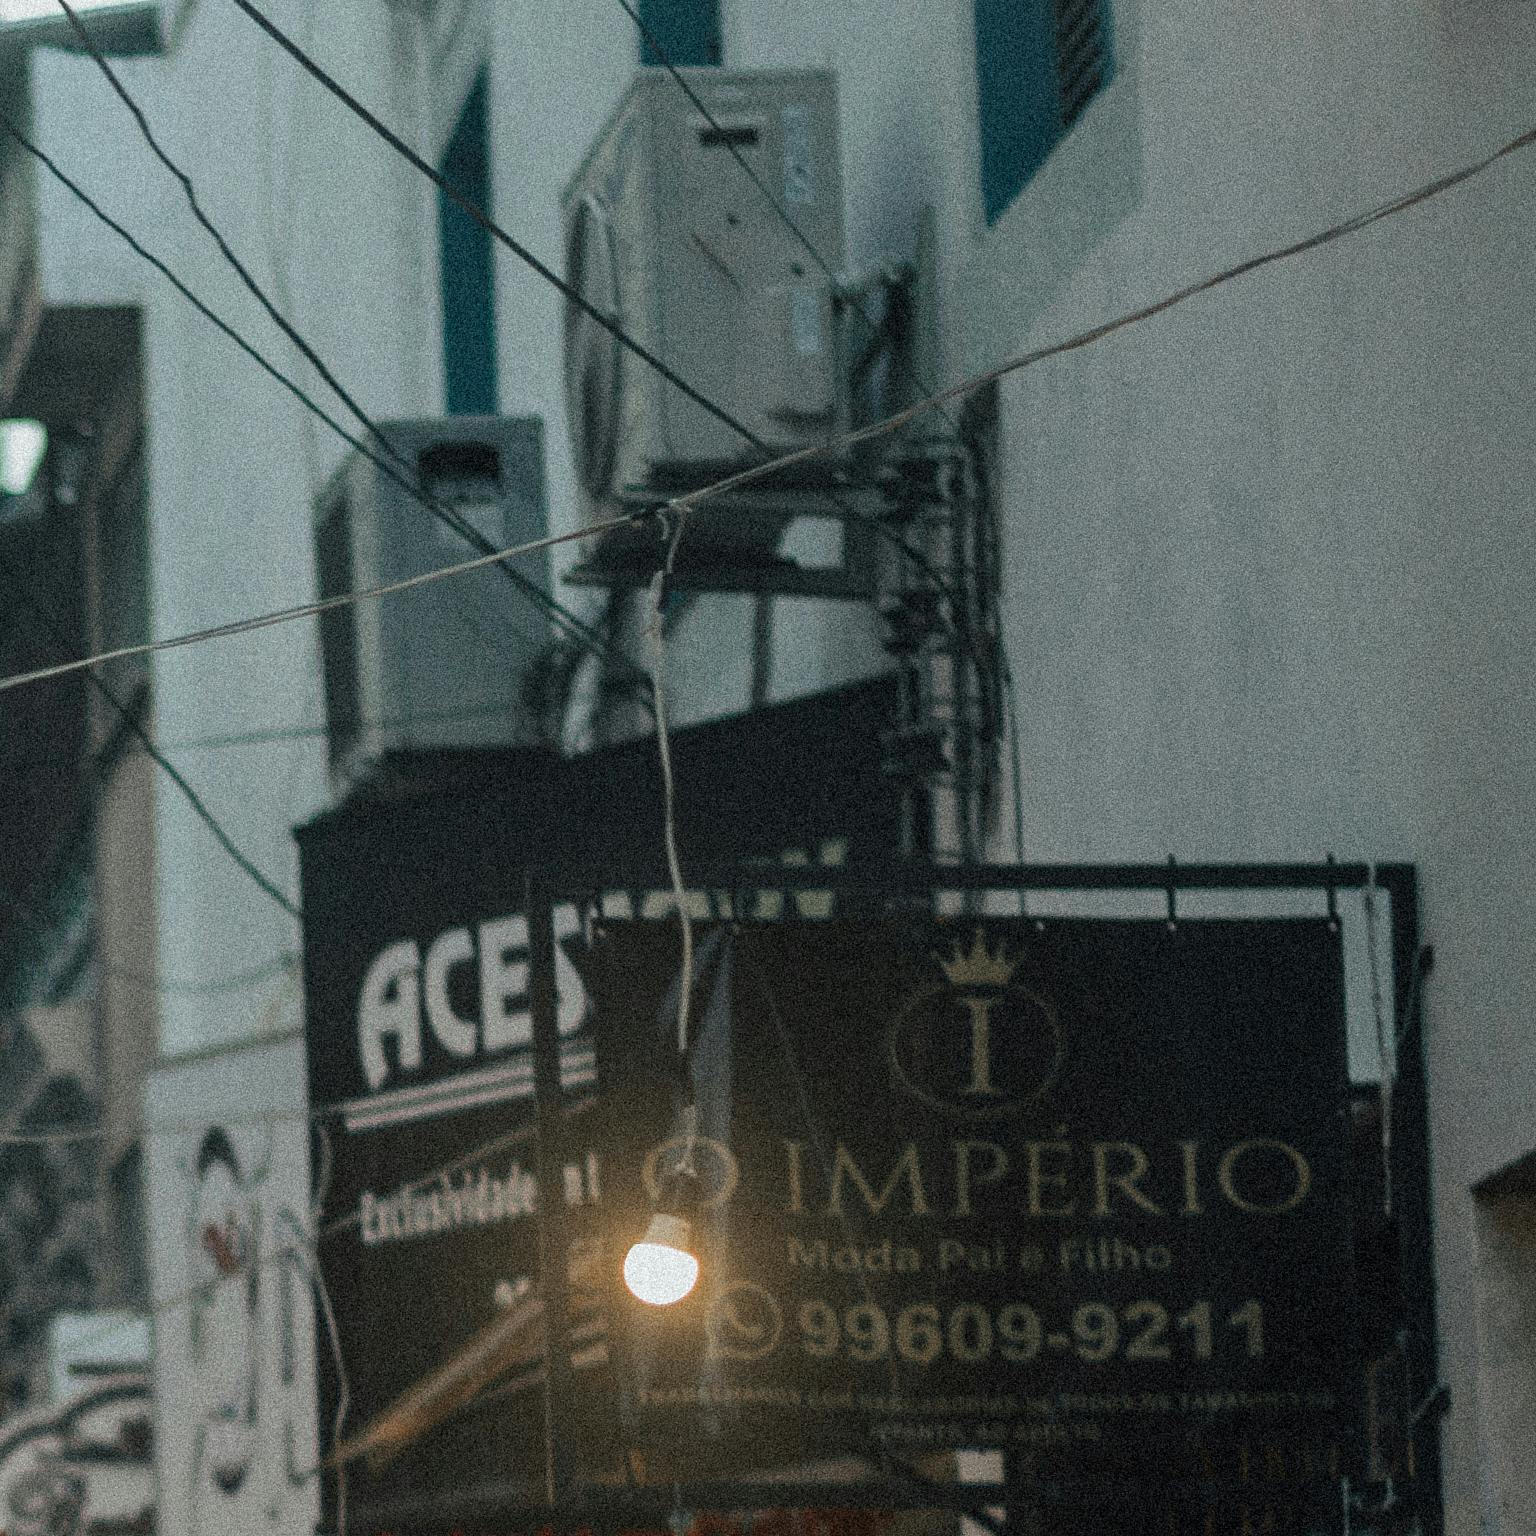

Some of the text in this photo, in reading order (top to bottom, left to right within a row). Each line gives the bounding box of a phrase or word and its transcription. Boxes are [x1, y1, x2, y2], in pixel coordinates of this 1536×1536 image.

[782, 1122, 1314, 1217] IMPÉRIO
[788, 1236, 1172, 1274] Moda Pai e Filho
[797, 1300, 1266, 1363] 99609-9211
